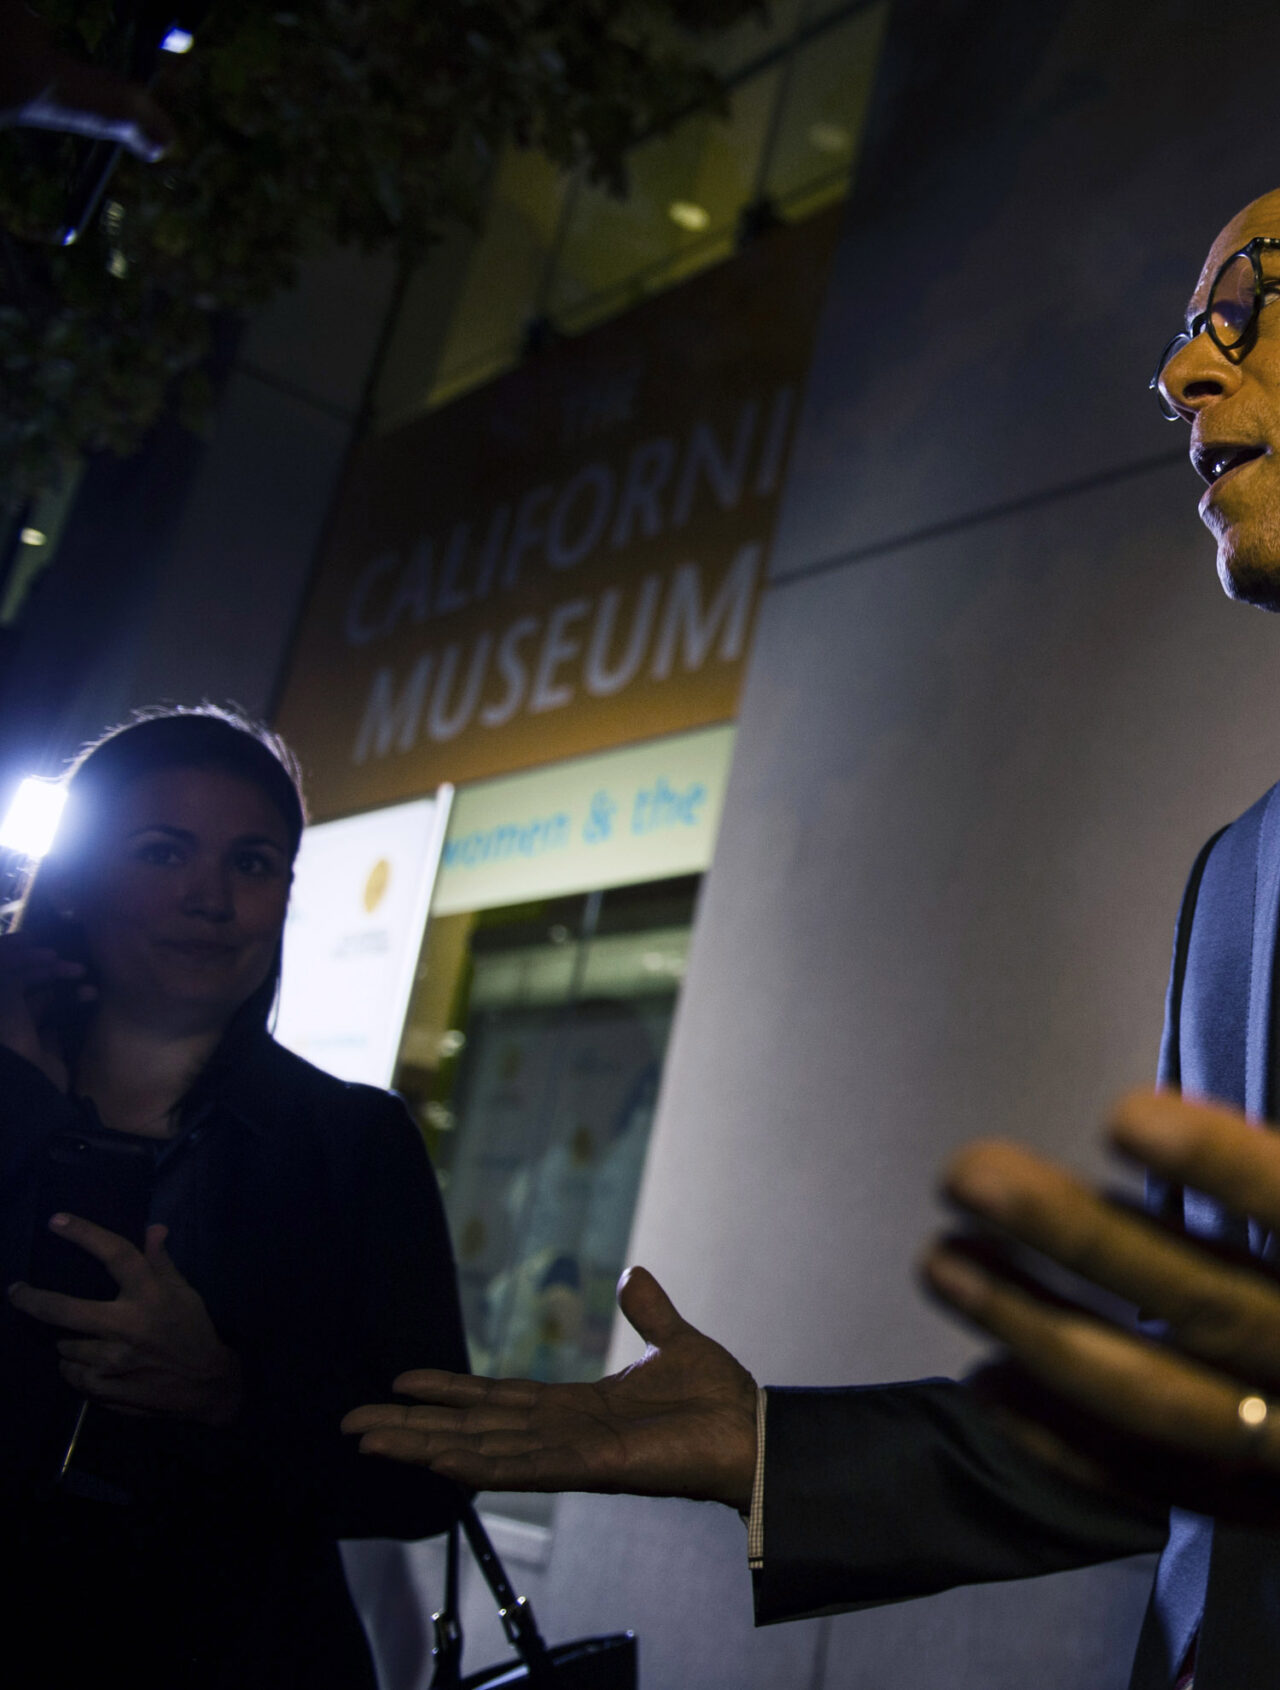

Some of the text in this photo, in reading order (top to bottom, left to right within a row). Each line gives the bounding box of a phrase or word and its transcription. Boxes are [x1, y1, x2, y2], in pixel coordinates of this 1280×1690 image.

[353, 540, 762, 765] MUSEUM
[583, 789, 618, 844] &
[632, 776, 707, 833] the
